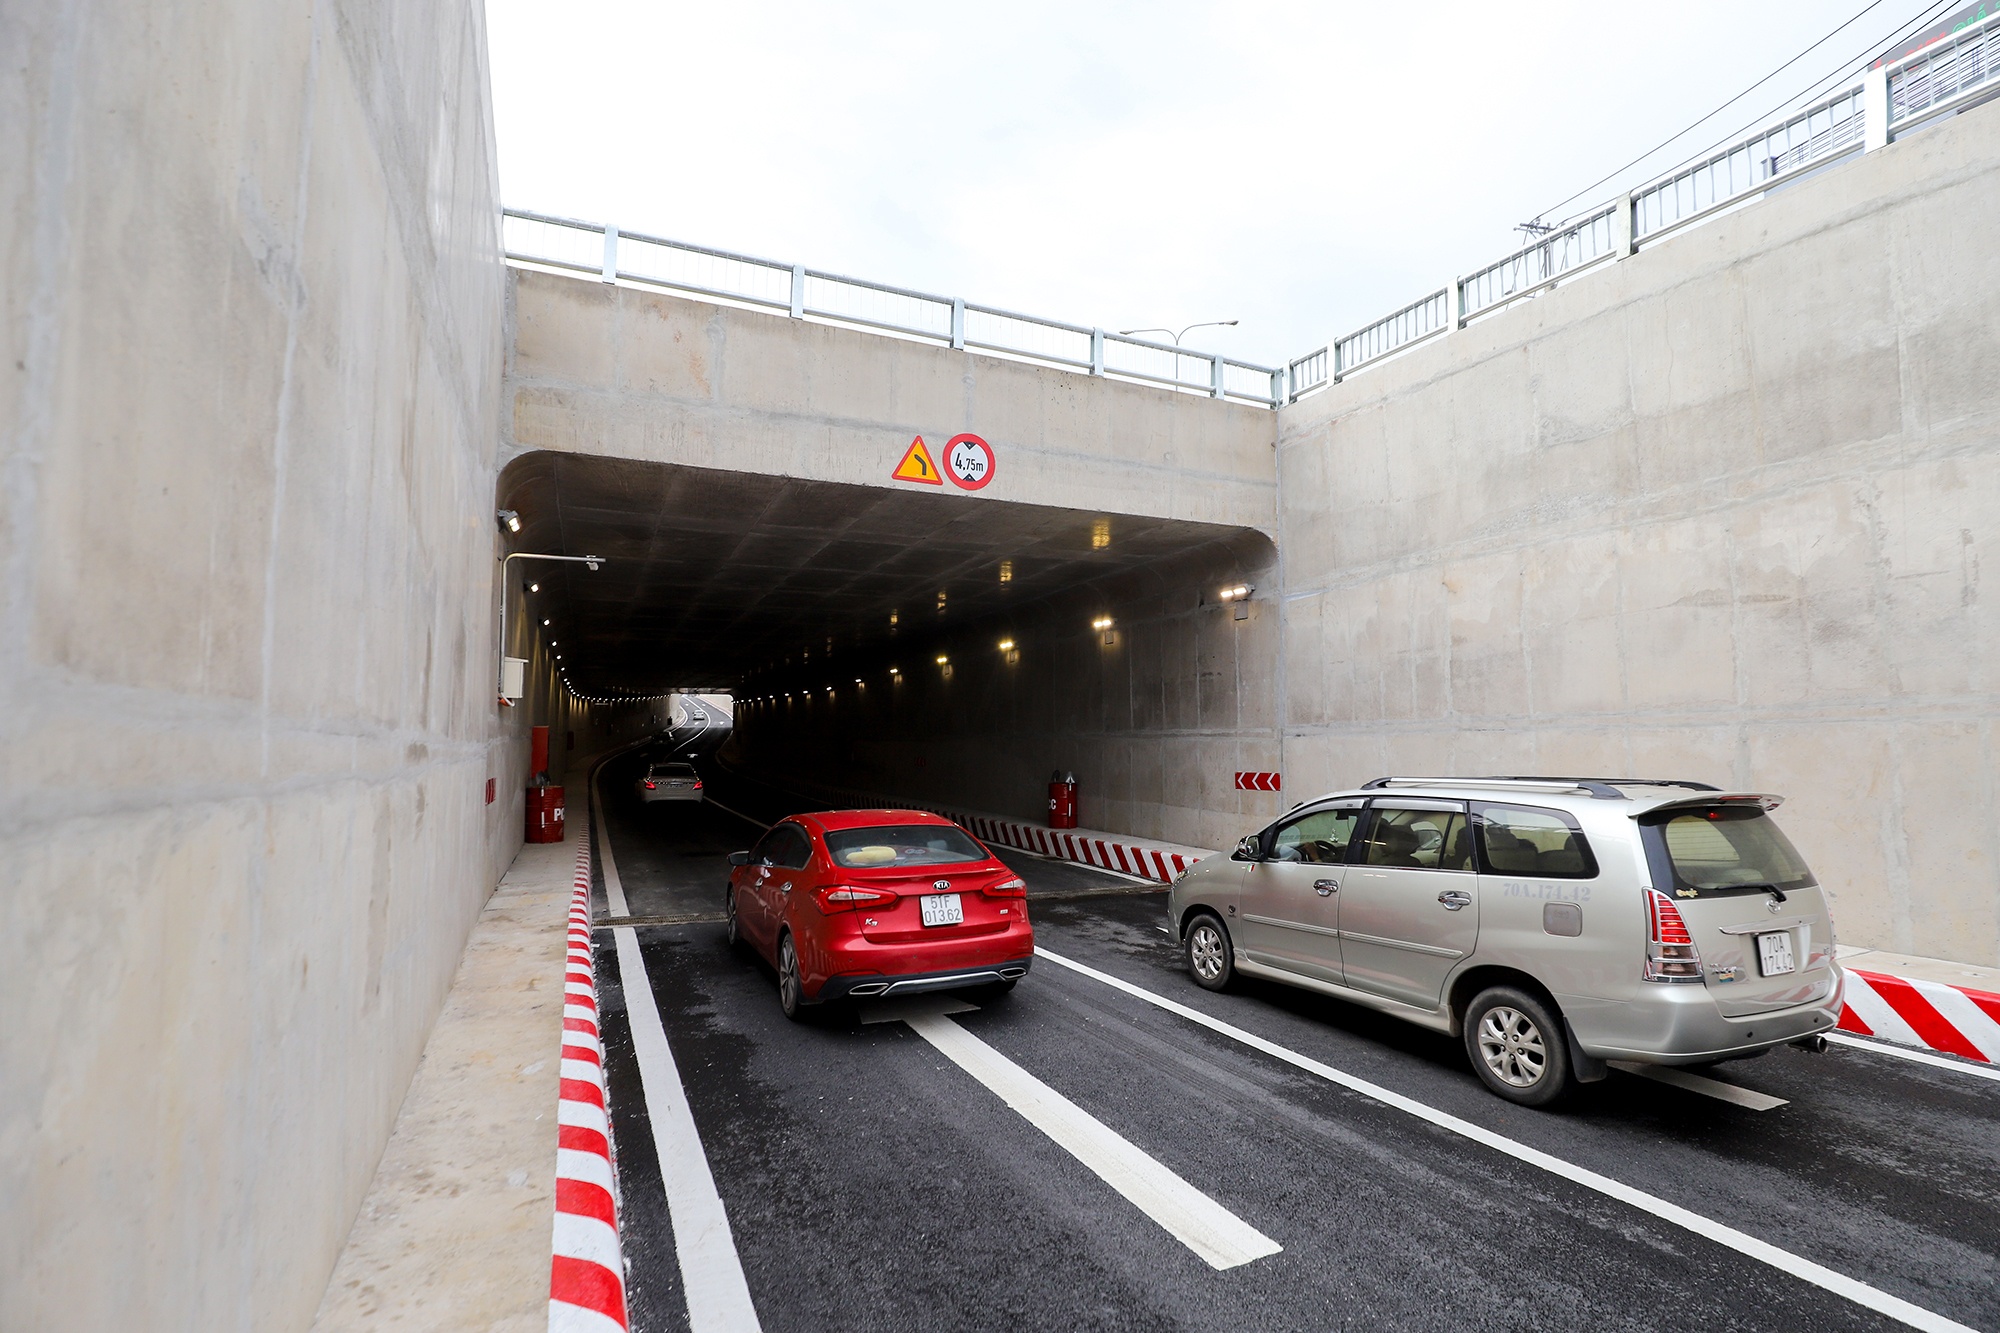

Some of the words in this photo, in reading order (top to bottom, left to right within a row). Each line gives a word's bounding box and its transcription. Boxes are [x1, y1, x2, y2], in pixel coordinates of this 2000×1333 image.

[955, 452, 984, 472] 4.75m
[931, 895, 950, 909] 51F
[924, 908, 961, 923] 013.62
[1766, 935, 1785, 953] 70A
